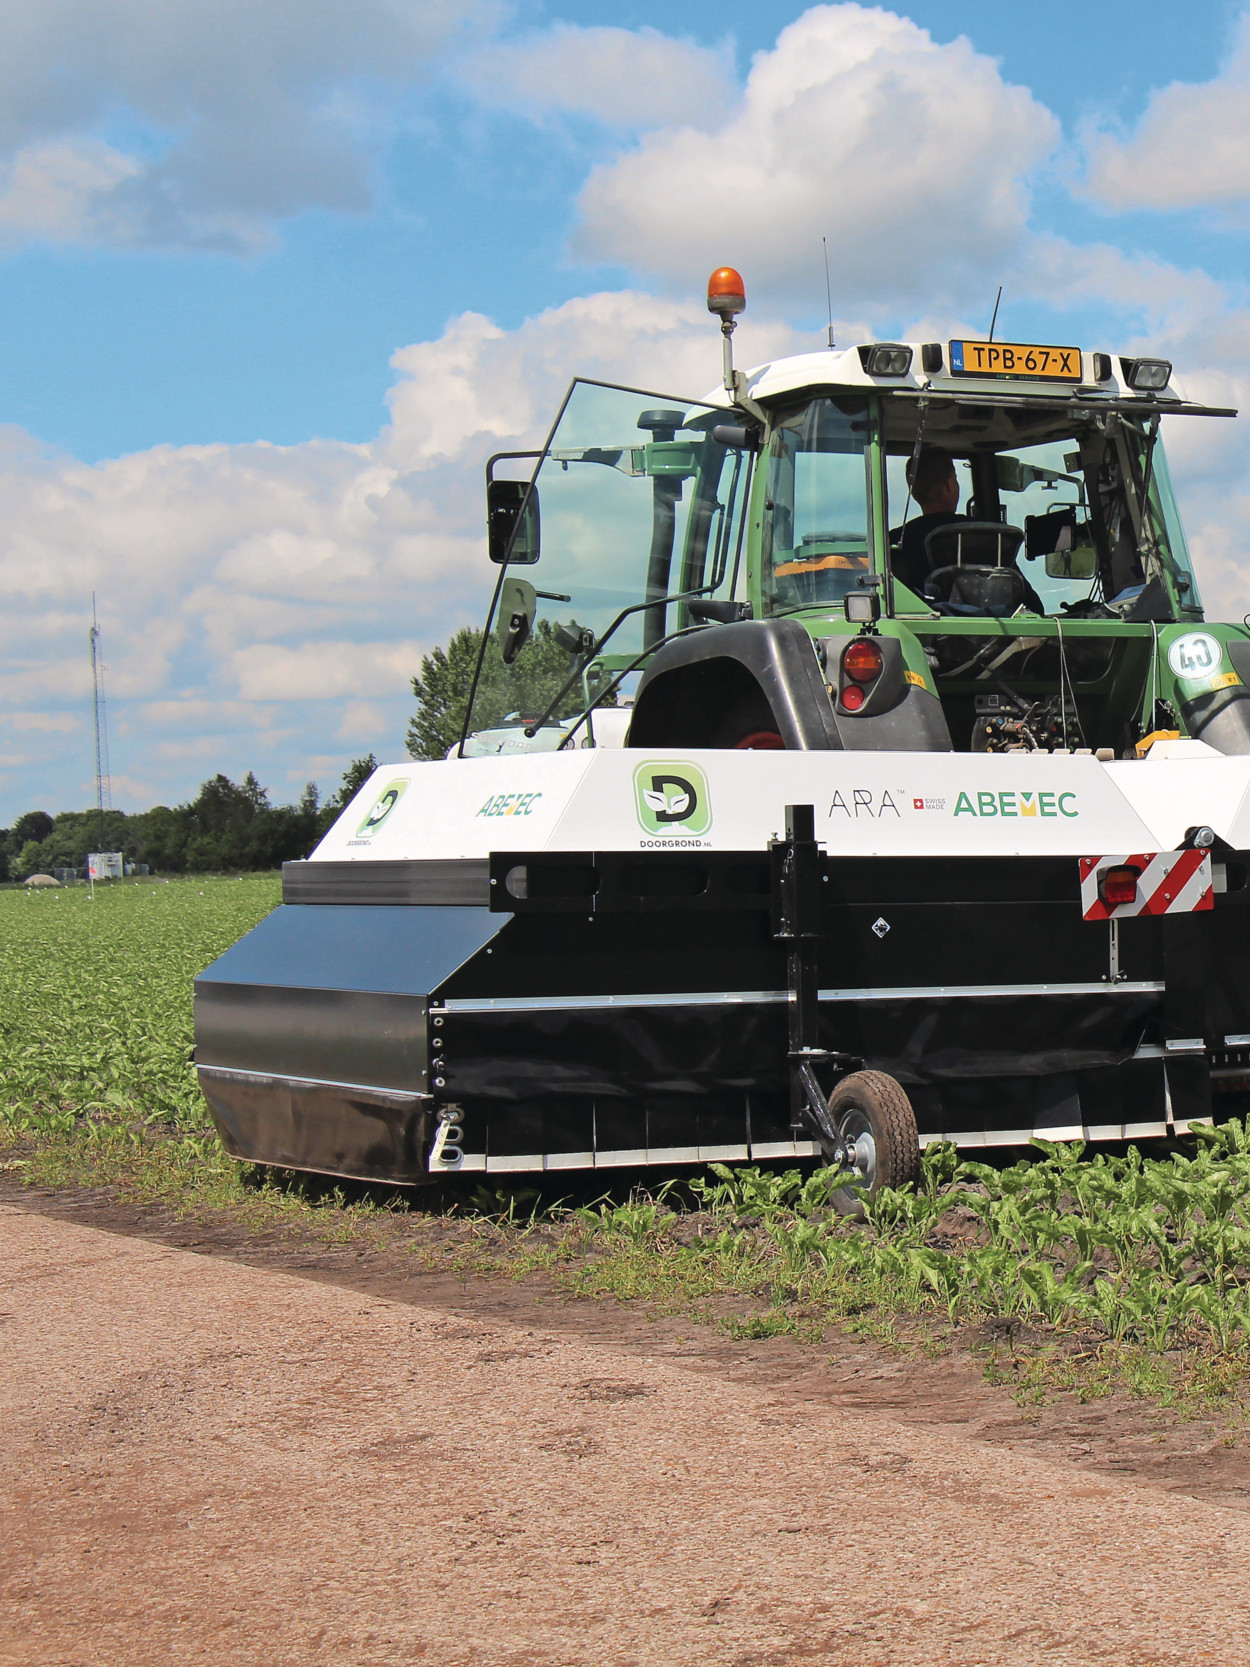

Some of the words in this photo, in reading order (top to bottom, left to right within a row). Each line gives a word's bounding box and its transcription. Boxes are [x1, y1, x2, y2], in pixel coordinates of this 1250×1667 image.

[953, 358, 963, 366] NL
[973, 347, 1072, 373] TPB-67-X
[1179, 639, 1213, 671] 40
[475, 792, 543, 818] ABEMEC
[953, 791, 1080, 818] ABEMEC
